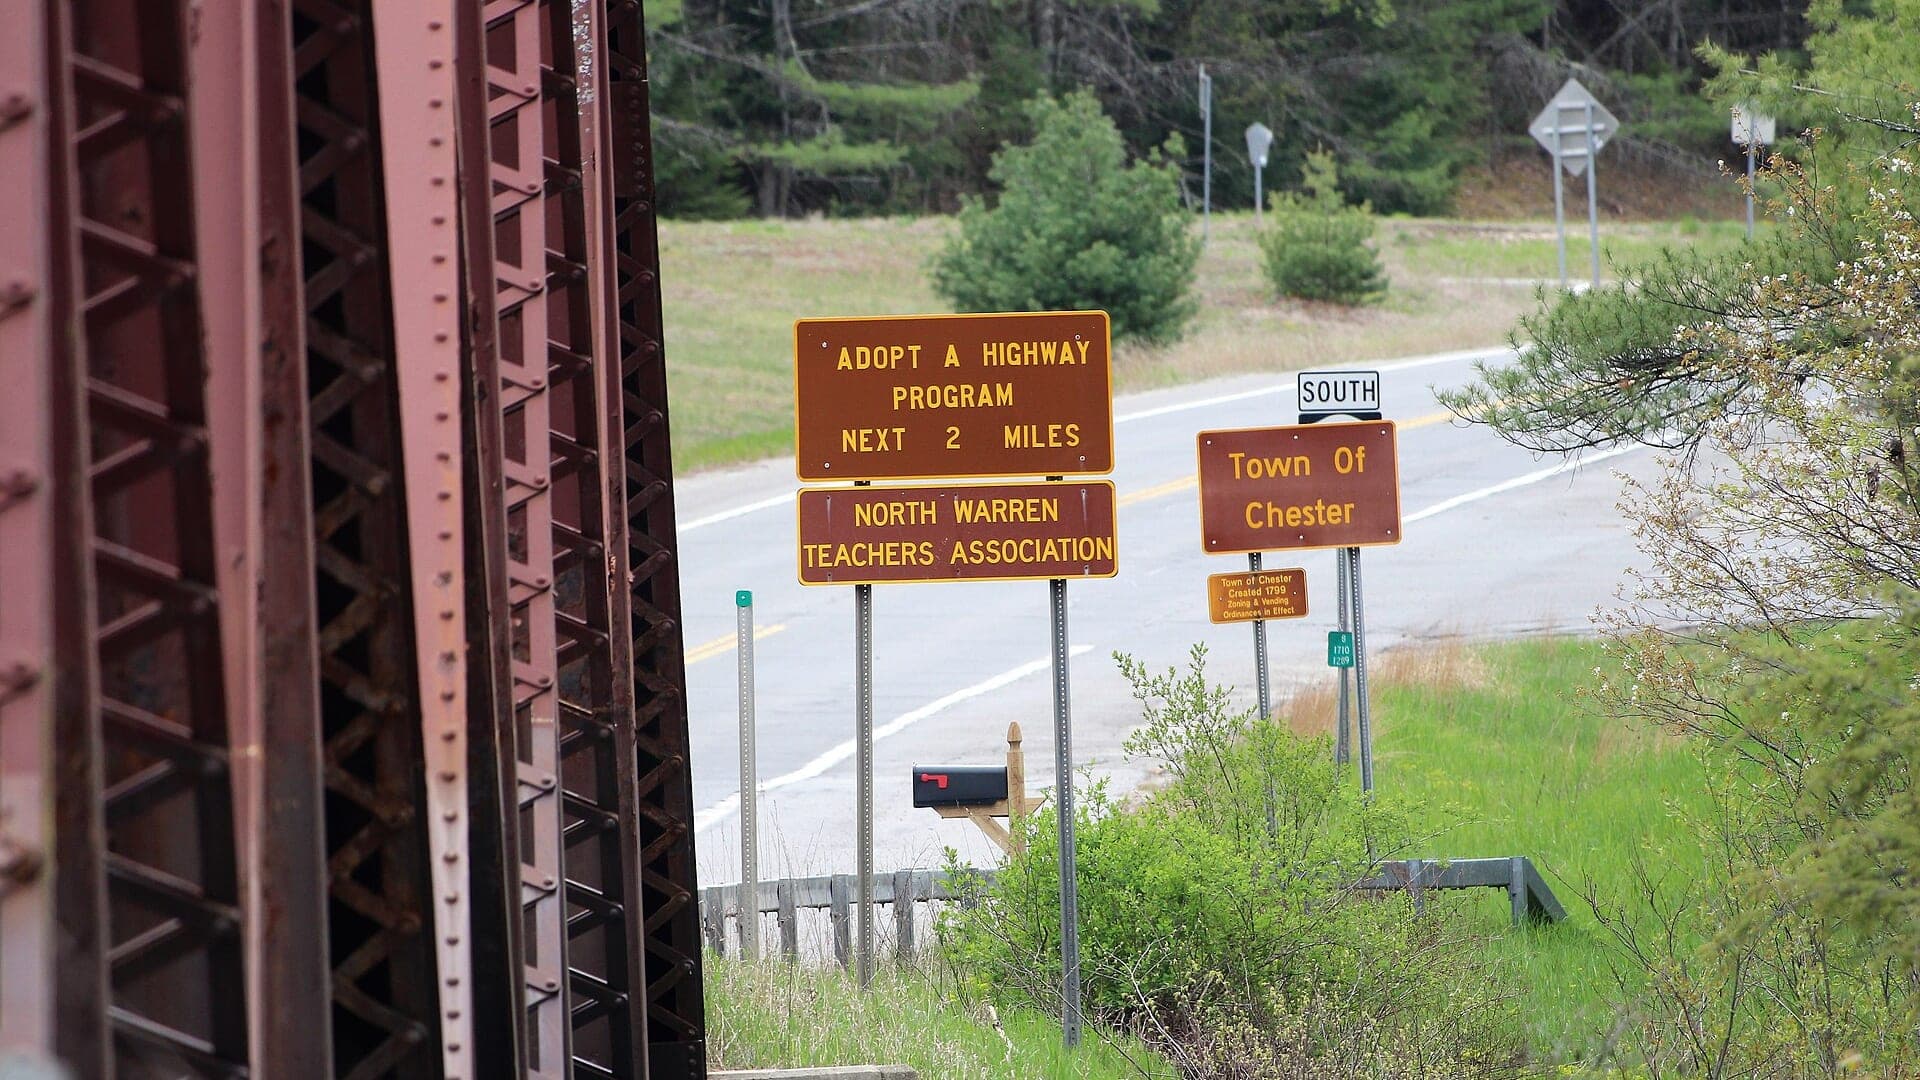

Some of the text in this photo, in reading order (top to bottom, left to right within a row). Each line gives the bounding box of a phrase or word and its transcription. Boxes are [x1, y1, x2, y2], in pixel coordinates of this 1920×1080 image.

[837, 340, 1090, 371] ADOPT A HIGHWAY
[892, 382, 1014, 411] PROGRAM
[1302, 379, 1376, 403] SOUTH
[841, 423, 1081, 453] NEXT 2 MILES
[1228, 445, 1366, 480] Town Of
[854, 498, 1059, 527] NORTH WARREN
[1245, 498, 1355, 529] Chester
[803, 536, 1114, 568] TEACHERS ASSOCIATION
[1221, 574, 1292, 587] Town of Chester
[1228, 585, 1287, 598] Created 1799
[1227, 599, 1251, 609] Zoning
[1273, 606, 1295, 615] Effect
[1334, 645, 1350, 655] 1710
